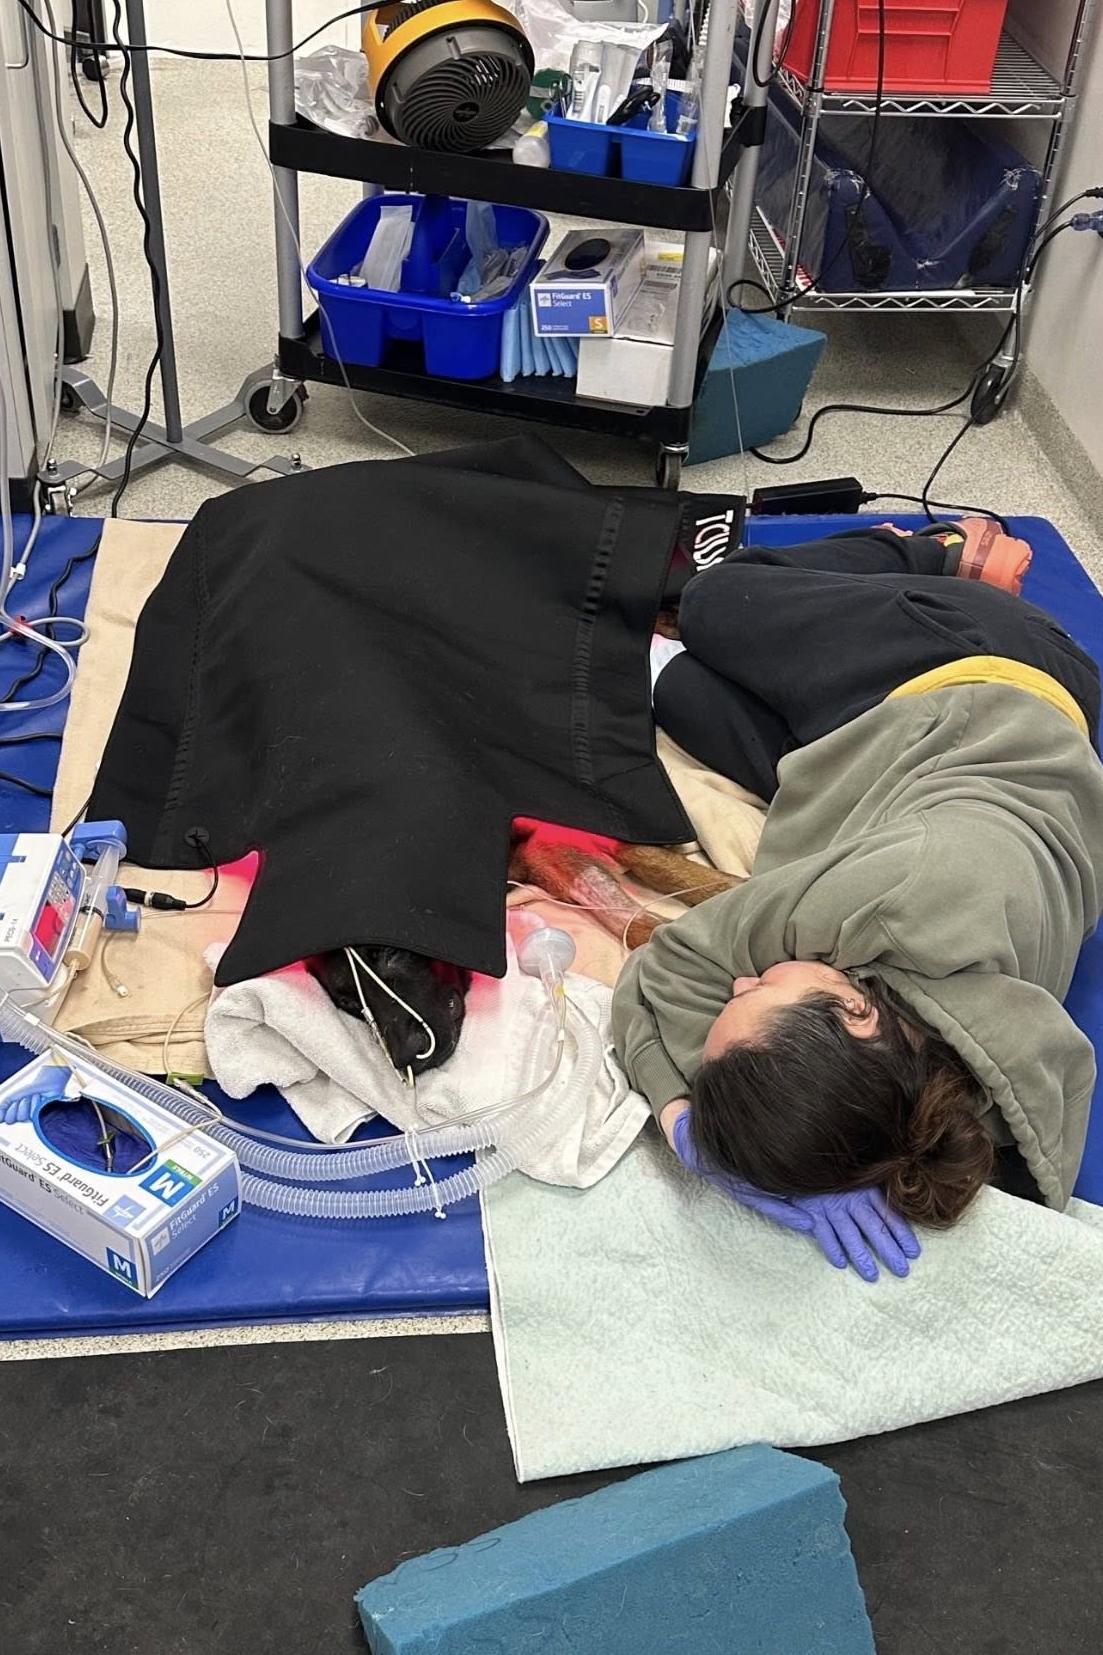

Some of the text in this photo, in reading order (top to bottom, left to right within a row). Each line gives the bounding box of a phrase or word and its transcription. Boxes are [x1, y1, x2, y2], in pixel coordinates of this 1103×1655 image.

[552, 292, 592, 300] FitGuard ES
[594, 318, 604, 329] S
[0, 1155, 84, 1215] tGuard ES Select
[15, 1143, 109, 1207] FitGuard ES Select
[149, 1172, 185, 1200] M
[169, 1182, 220, 1231] FitGuard ES
[222, 1200, 235, 1220] M
[113, 1253, 132, 1278] M
